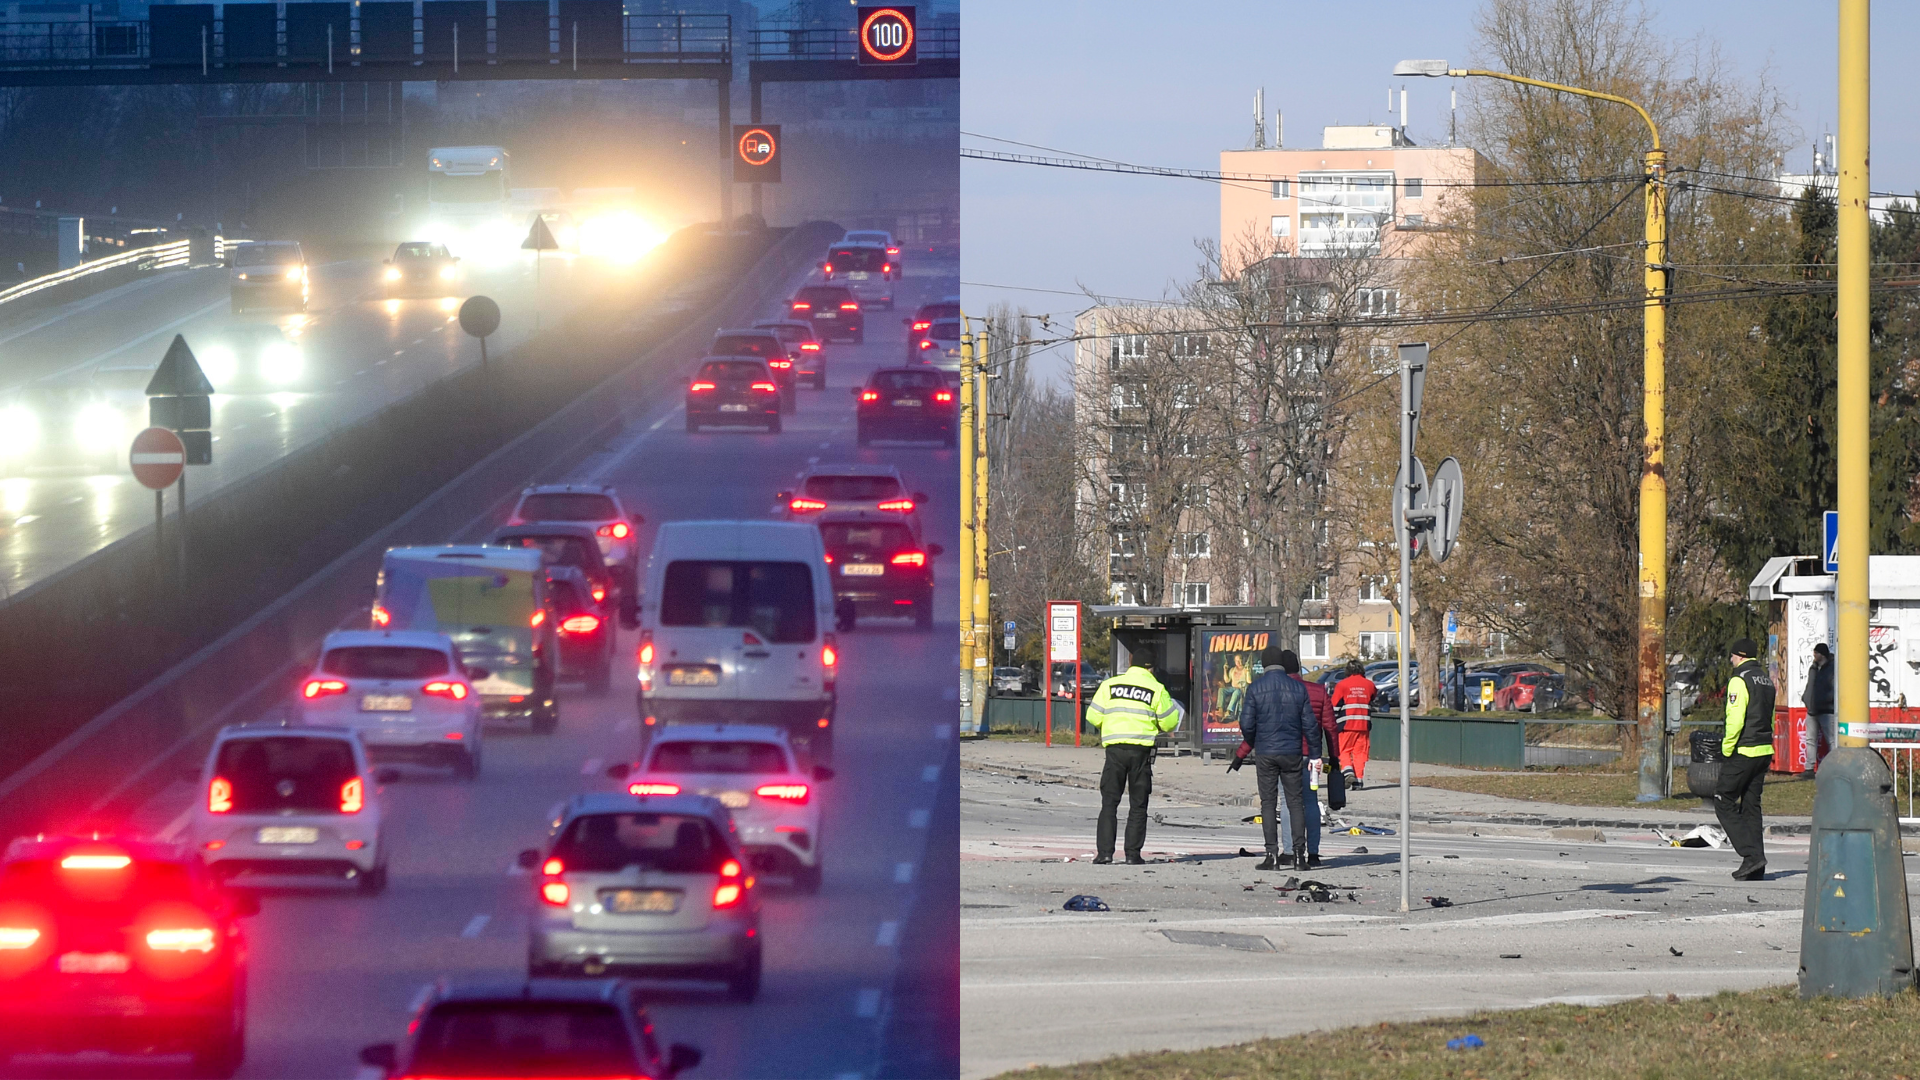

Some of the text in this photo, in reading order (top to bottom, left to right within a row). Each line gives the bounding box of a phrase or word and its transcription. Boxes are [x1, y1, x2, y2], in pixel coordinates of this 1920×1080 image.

[872, 23, 902, 47] 100
[1209, 632, 1269, 652] INVALID
[1110, 686, 1152, 704] POLÍCIA
